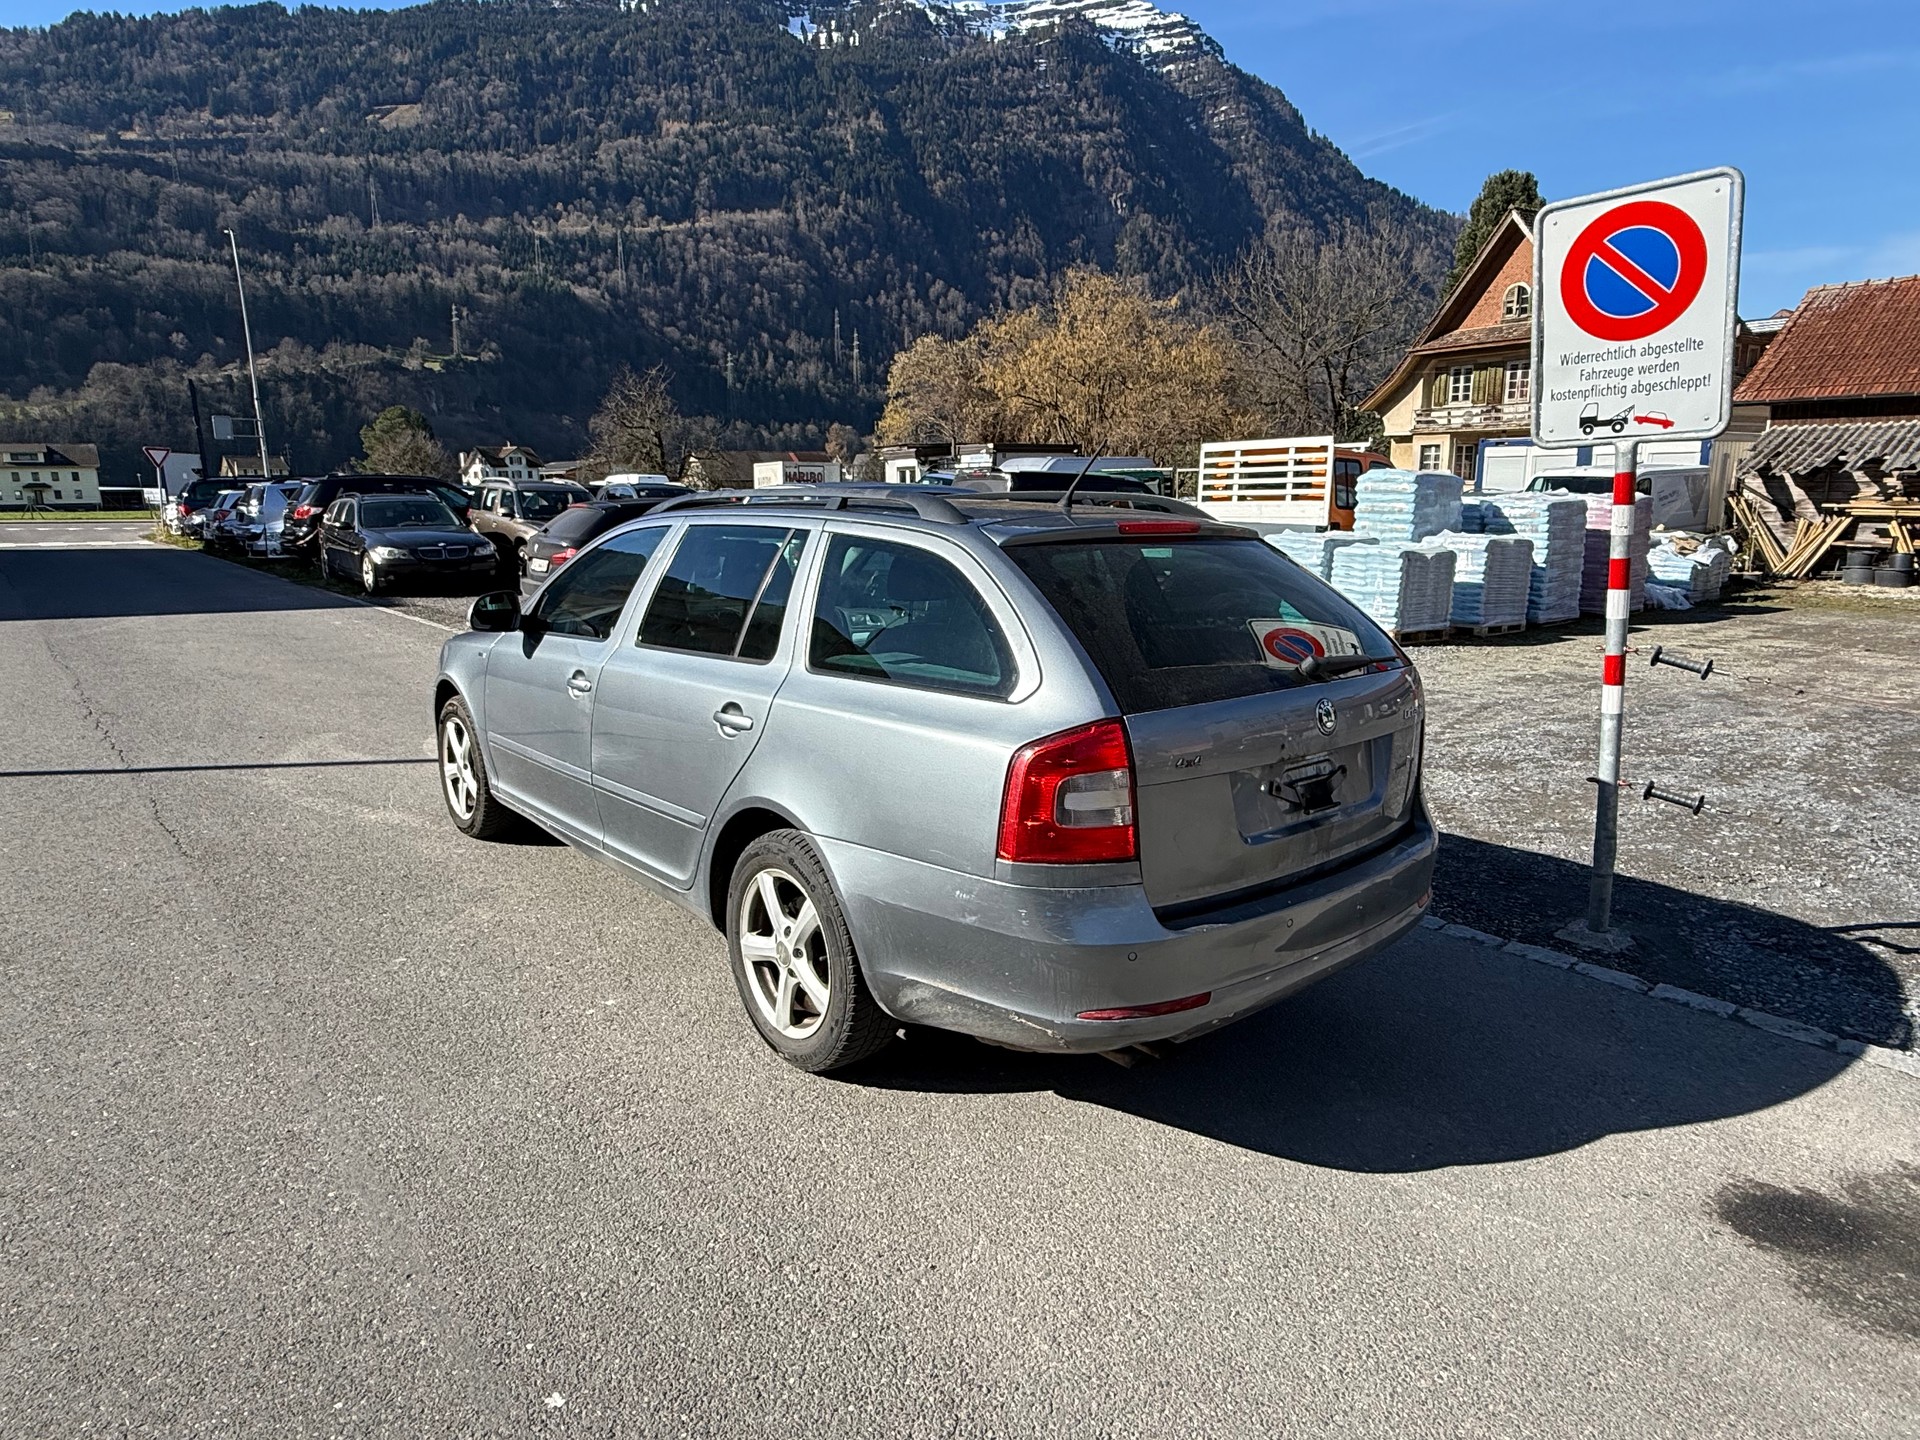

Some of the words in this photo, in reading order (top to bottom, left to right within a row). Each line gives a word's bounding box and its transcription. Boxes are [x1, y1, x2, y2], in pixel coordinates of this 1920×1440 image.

[1560, 345, 1636, 366] Widerrechtlich
[1640, 337, 1704, 358] abgestellte
[1579, 366, 1634, 382] Fahrzeuge
[1638, 359, 1680, 375] werden
[1550, 384, 1628, 402] kostenpflichtig
[1631, 373, 1711, 396] abgeschleppt!
